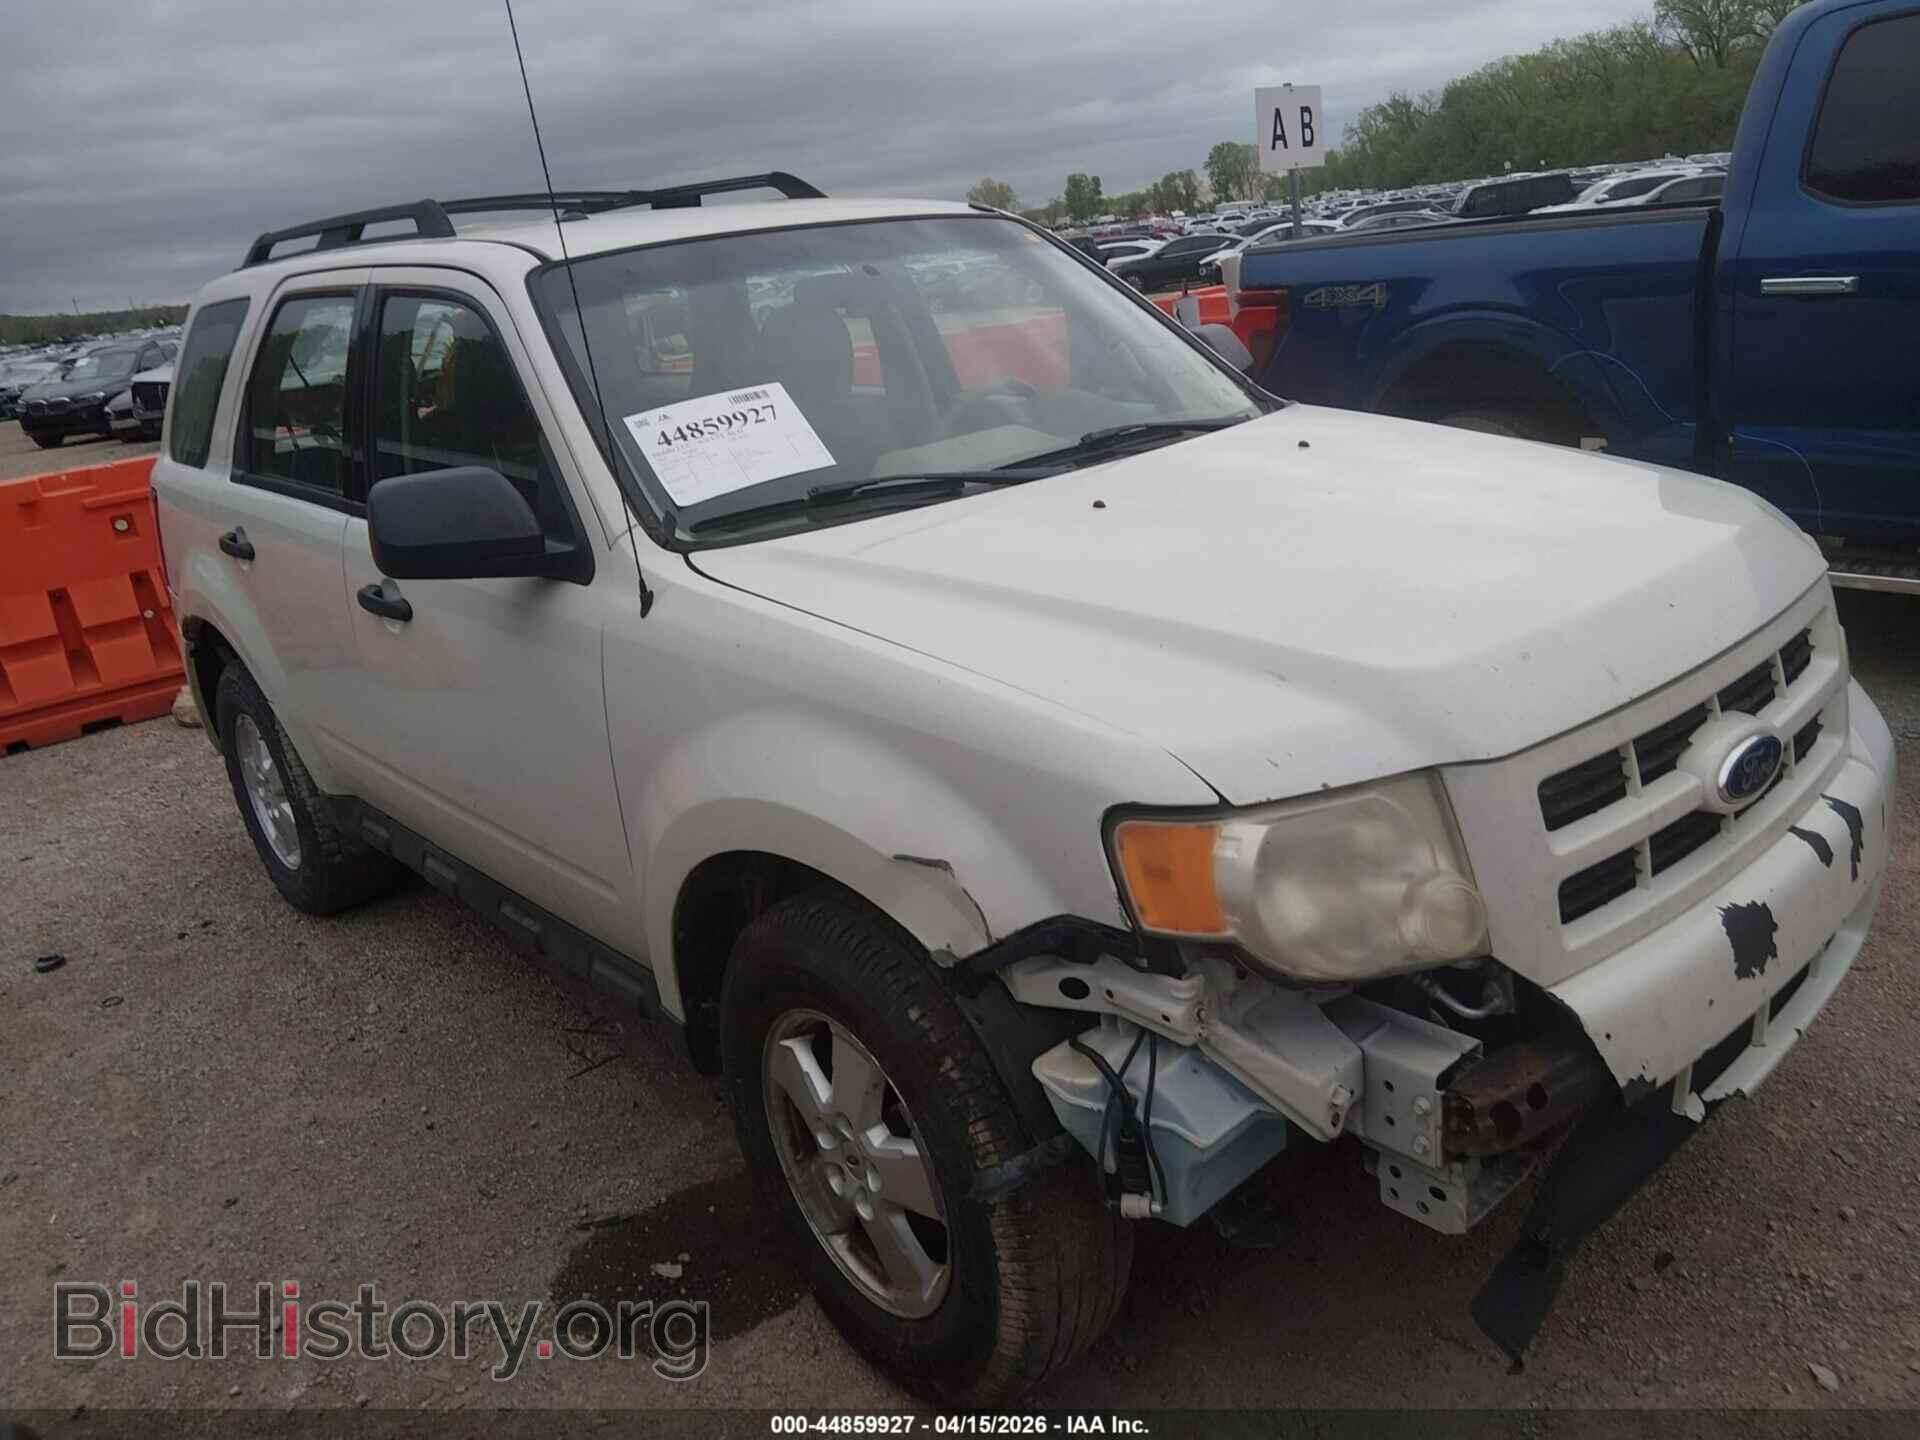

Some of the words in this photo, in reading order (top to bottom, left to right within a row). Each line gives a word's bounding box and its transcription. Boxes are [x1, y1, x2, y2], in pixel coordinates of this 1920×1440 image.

[1271, 107, 1288, 150] A
[1300, 105, 1315, 148] B
[656, 403, 778, 447] 44859927
